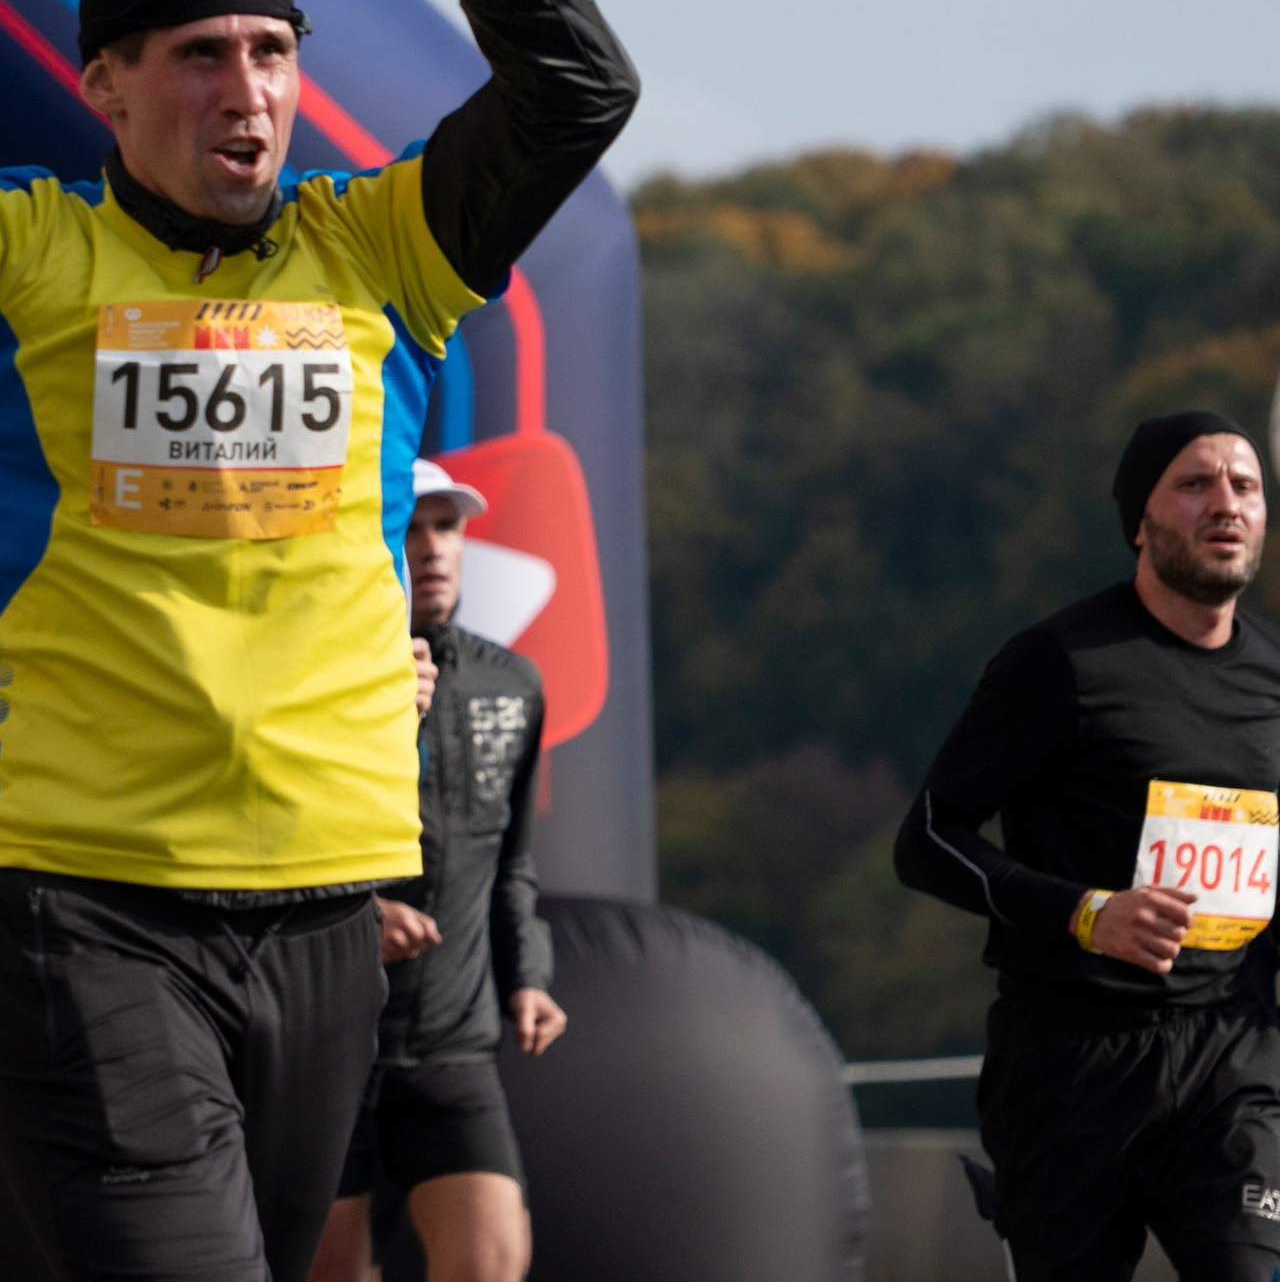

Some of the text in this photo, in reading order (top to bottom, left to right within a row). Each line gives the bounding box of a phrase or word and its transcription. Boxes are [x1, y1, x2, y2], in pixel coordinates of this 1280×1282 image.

[111, 362, 341, 433] 15615
[169, 437, 278, 461] ВИТАЛИЙ
[1149, 838, 1271, 895] 19014
